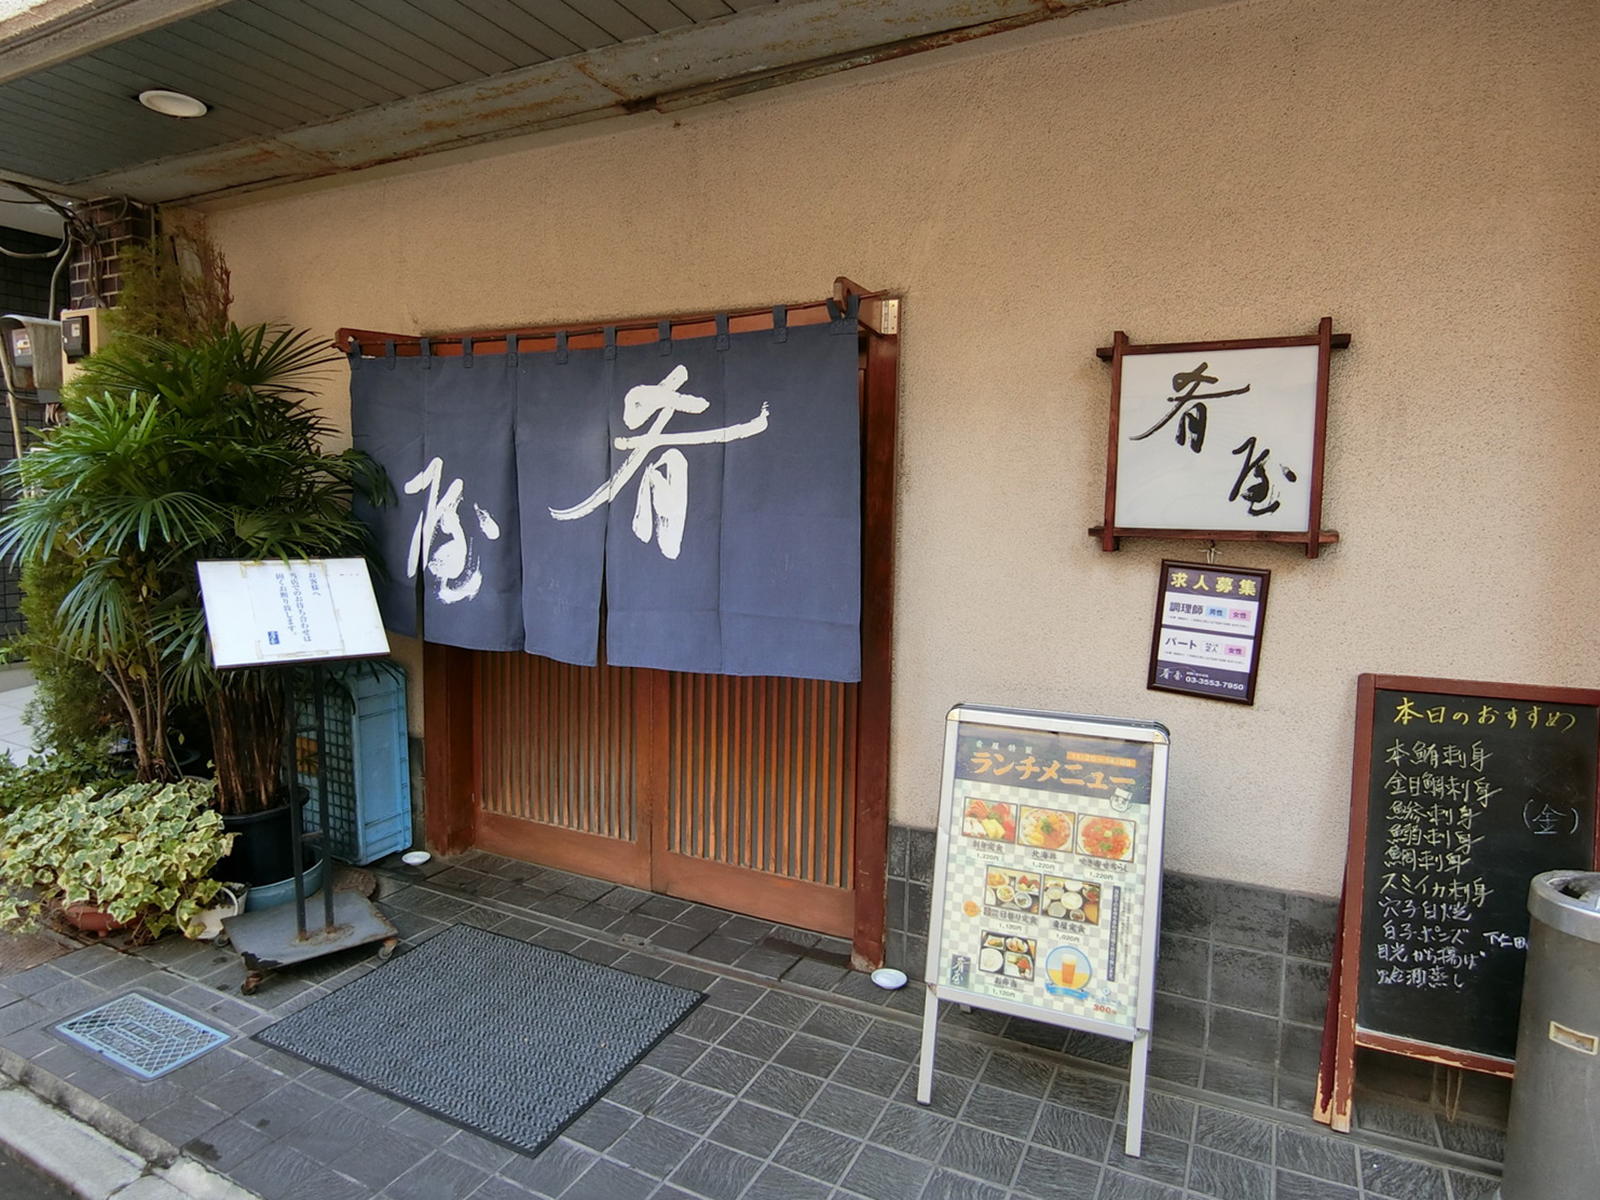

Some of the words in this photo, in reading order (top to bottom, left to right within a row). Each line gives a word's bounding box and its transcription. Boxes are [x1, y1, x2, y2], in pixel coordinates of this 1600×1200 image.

[1170, 572, 1256, 596] 求人募集
[1169, 601, 1203, 616] 調理師
[1209, 608, 1224, 617] 男性
[1233, 611, 1247, 620] 女性
[1228, 647, 1242, 656] 女性
[1185, 675, 1244, 691] 03-3553-7950
[1393, 696, 1577, 734] 本日のおすすめ
[1385, 739, 1494, 772] 本鮪刺身
[970, 752, 1136, 790] ランチメニュー
[1384, 769, 1503, 808] 金目鯛刺身
[1386, 823, 1486, 855] 鰯刺身
[1383, 845, 1472, 874] 鯛刺身
[1380, 873, 1495, 908] スミイカ刺身
[1382, 919, 1470, 945] 白子ポンズ
[1482, 931, 1529, 950] 下仁田
